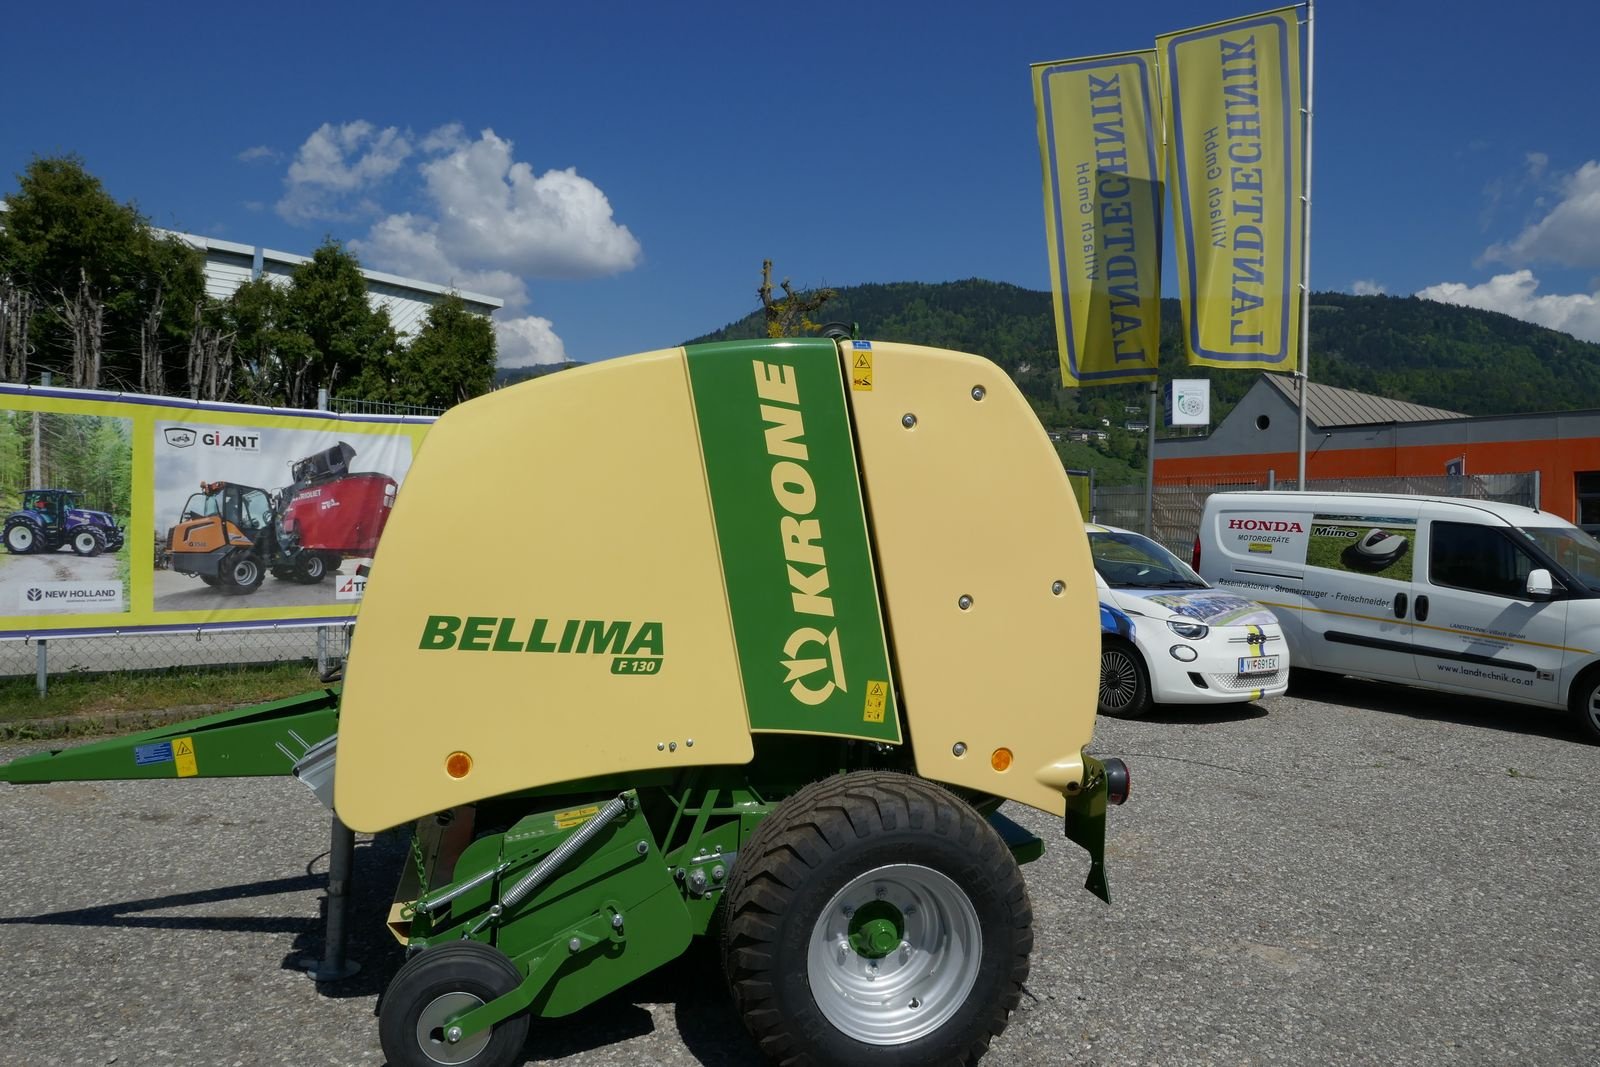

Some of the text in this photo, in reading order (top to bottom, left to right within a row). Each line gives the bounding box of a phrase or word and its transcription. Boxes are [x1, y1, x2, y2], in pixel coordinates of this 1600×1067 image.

[752, 359, 835, 618] KRONE
[1228, 519, 1304, 533] HONDA
[1314, 526, 1358, 538] Miimo
[45, 589, 116, 598] NEW HOLLAND
[1218, 578, 1269, 591] Rasentraktoren
[1274, 584, 1328, 599] Stromerzeuger
[1335, 592, 1391, 607] Freischneider
[418, 615, 664, 656] BELLIMA
[617, 660, 656, 673] F 130
[1437, 663, 1534, 686] www.landtechnik.co.at
